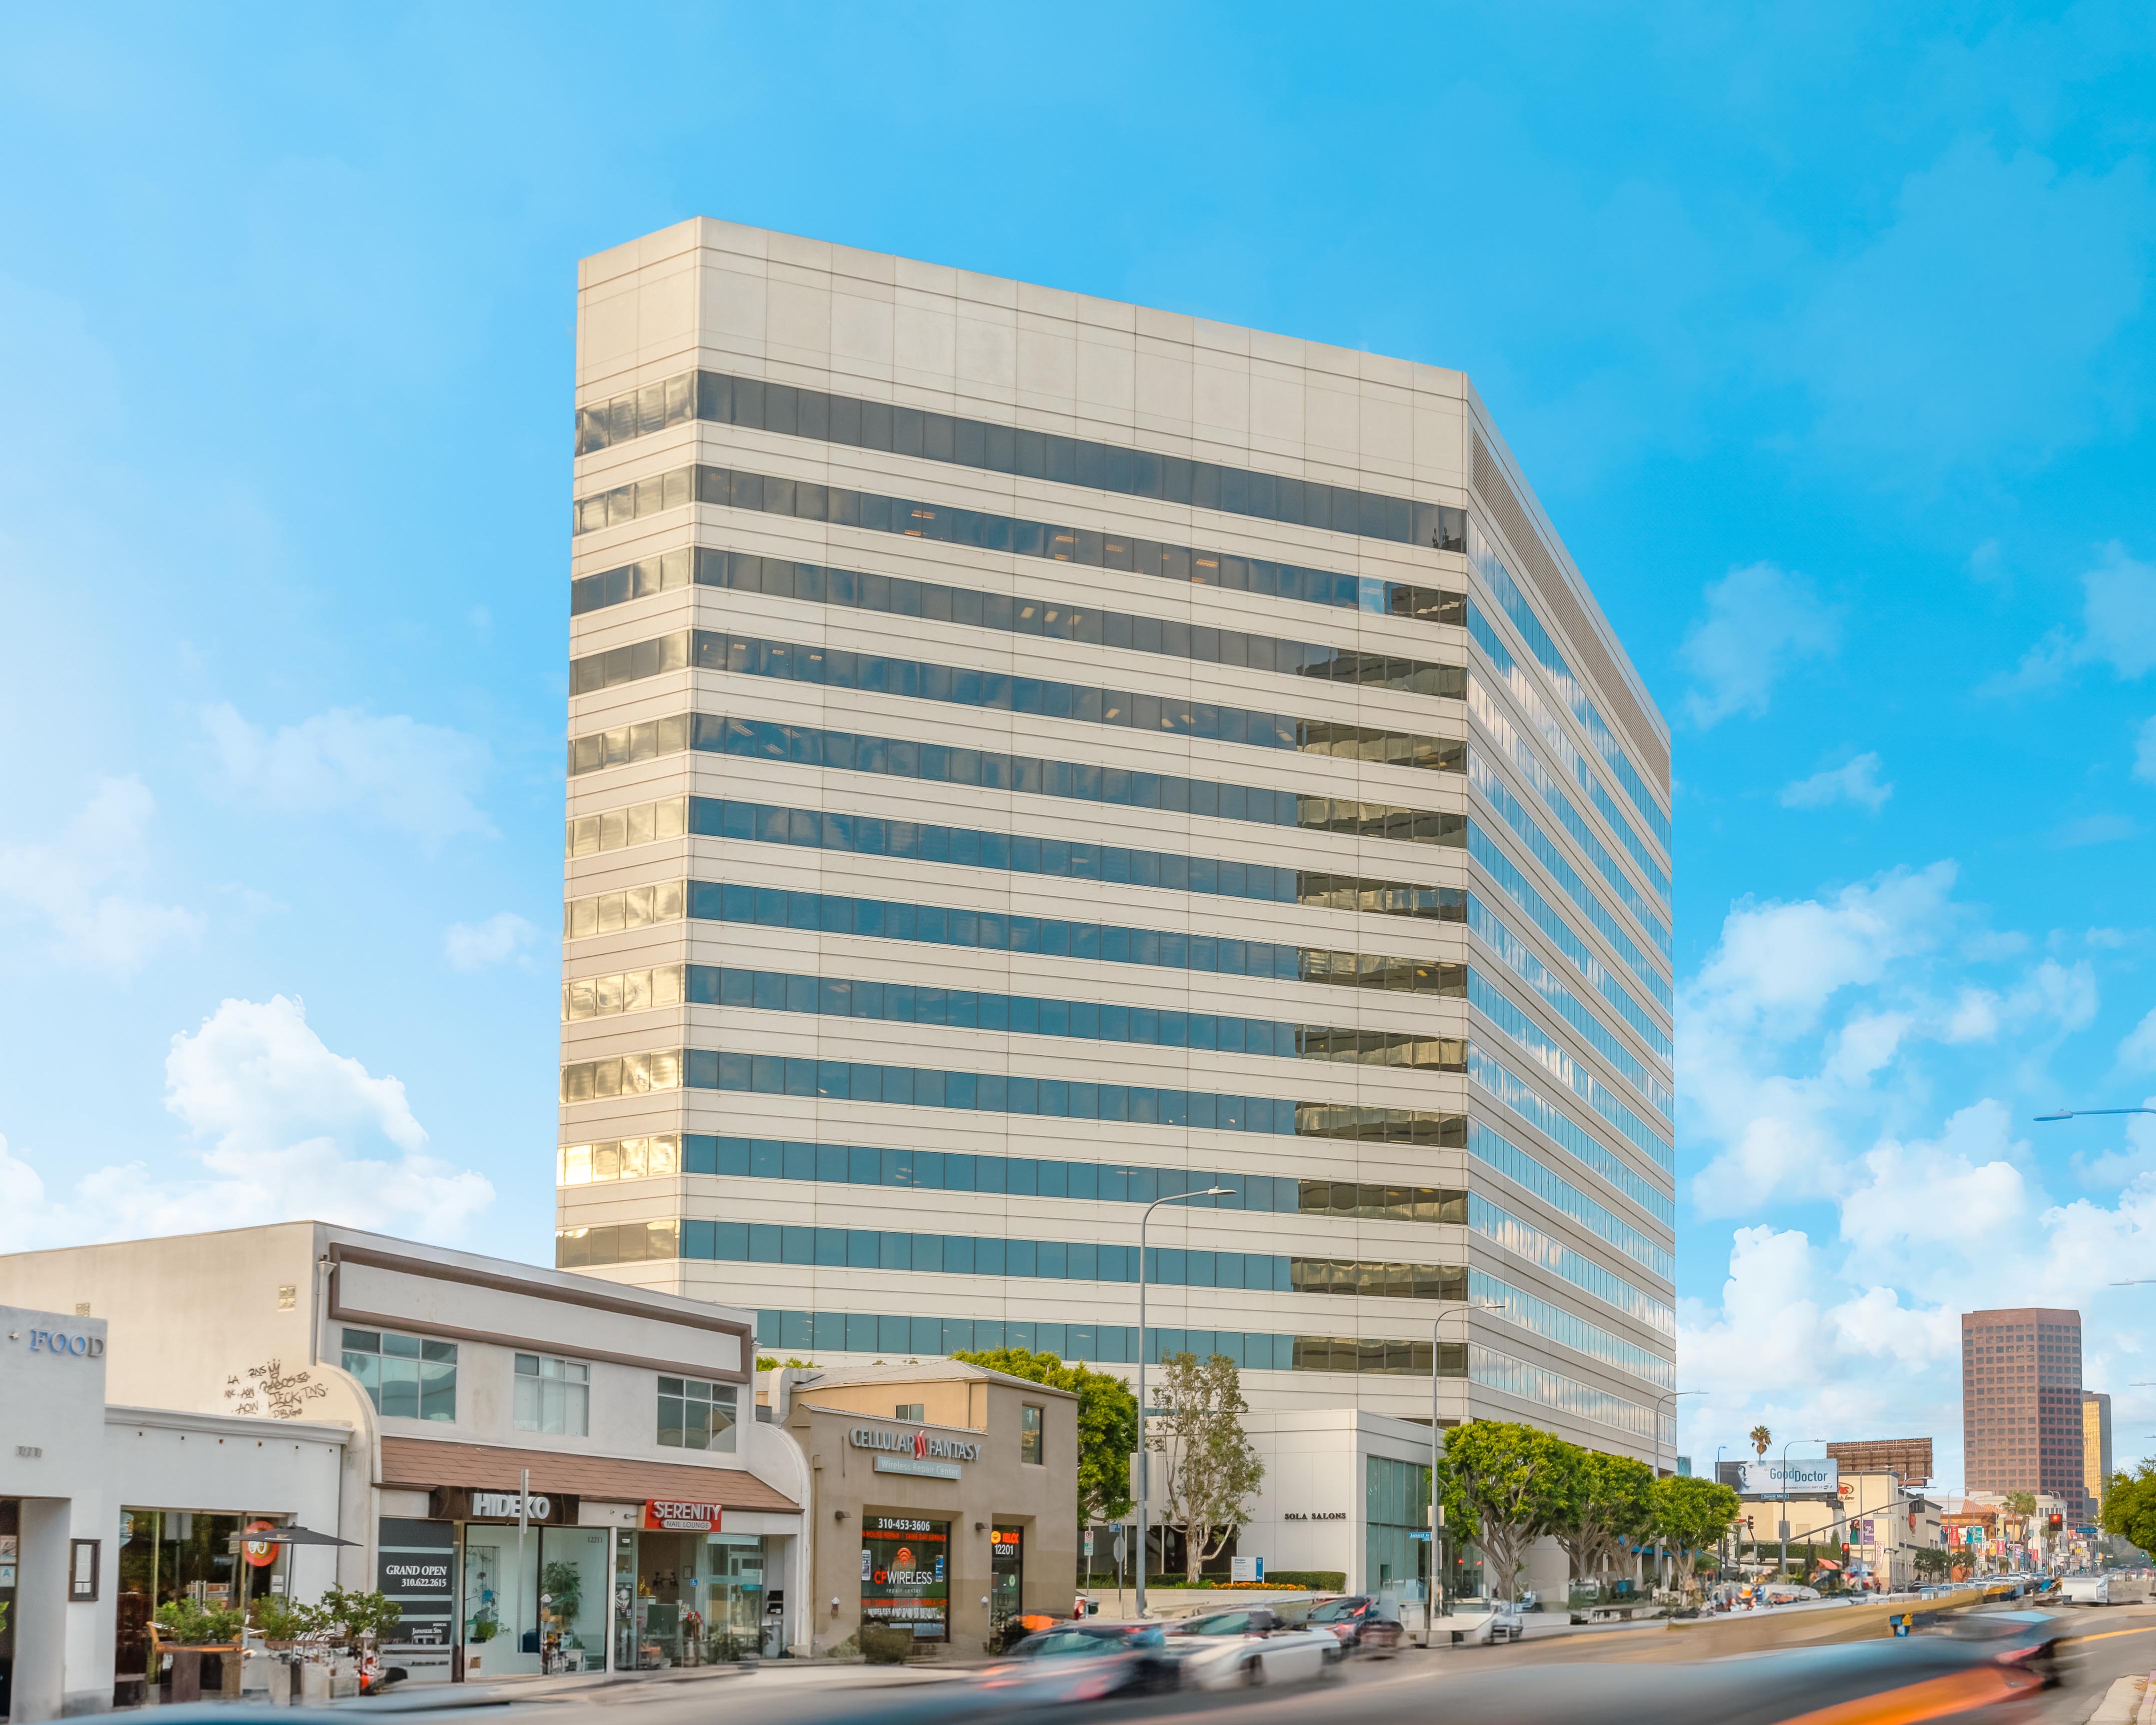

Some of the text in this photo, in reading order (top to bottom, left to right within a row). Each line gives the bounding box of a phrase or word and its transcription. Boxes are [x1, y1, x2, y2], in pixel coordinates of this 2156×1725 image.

[29, 1328, 104, 1358] FOOD
[228, 1375, 239, 1384] LA
[850, 1428, 982, 1461] CELLULAR FANTASY
[882, 1459, 958, 1476] Wireless Repair Center
[1770, 1468, 1828, 1482] Good Doctor
[472, 1493, 550, 1520] HIDEKO
[652, 1501, 722, 1520] SERENITY
[878, 1518, 931, 1531] 310-453-3606
[995, 1544, 1014, 1555] 12201
[2, 1568, 10, 1578] A
[386, 1565, 447, 1576] GRAND OPEN
[401, 1578, 447, 1587] 310.622.2615
